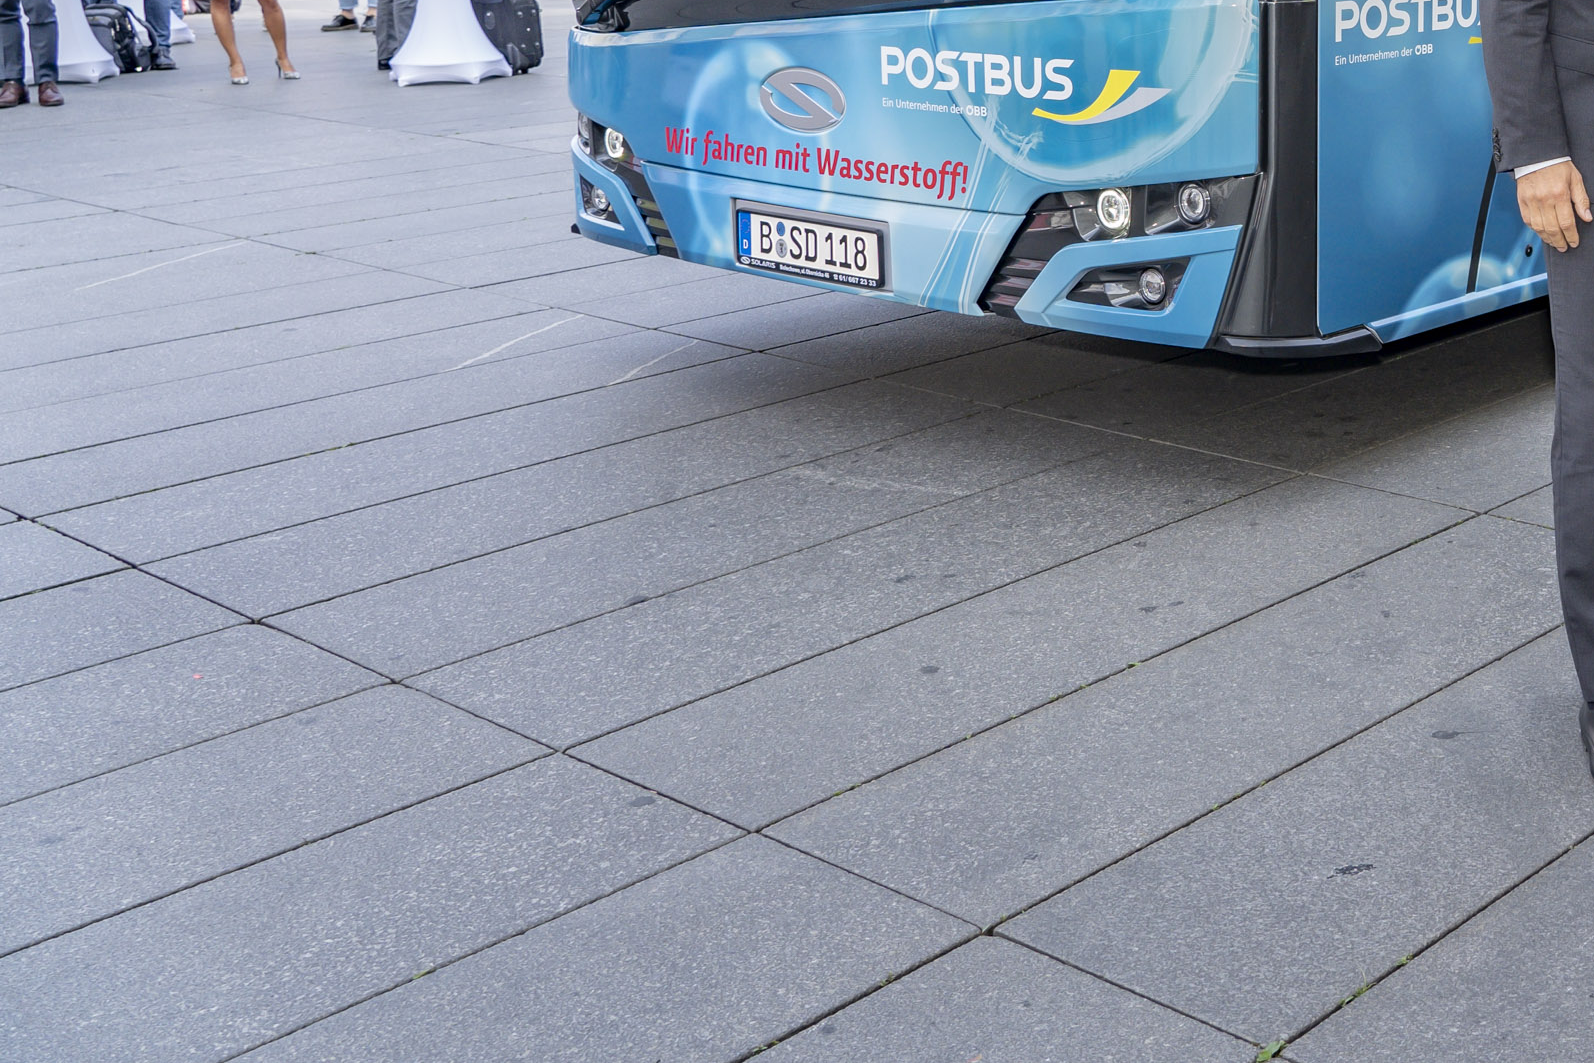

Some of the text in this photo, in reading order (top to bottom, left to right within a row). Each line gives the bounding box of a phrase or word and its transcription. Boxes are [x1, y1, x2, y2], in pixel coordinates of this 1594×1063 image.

[1334, 55, 1347, 66] Ein
[1348, 51, 1400, 65] Unternehmen
[1401, 46, 1413, 57] der
[880, 45, 1075, 101] POSTBUS
[881, 97, 894, 109] Ein
[895, 99, 949, 115] Unternehmen
[950, 103, 964, 116] der
[664, 126, 969, 202] Wir fahren mit Wasserstoff!
[743, 239, 749, 250] D
[760, 220, 868, 271] B SD 118
[750, 258, 776, 269] SOLARIS
